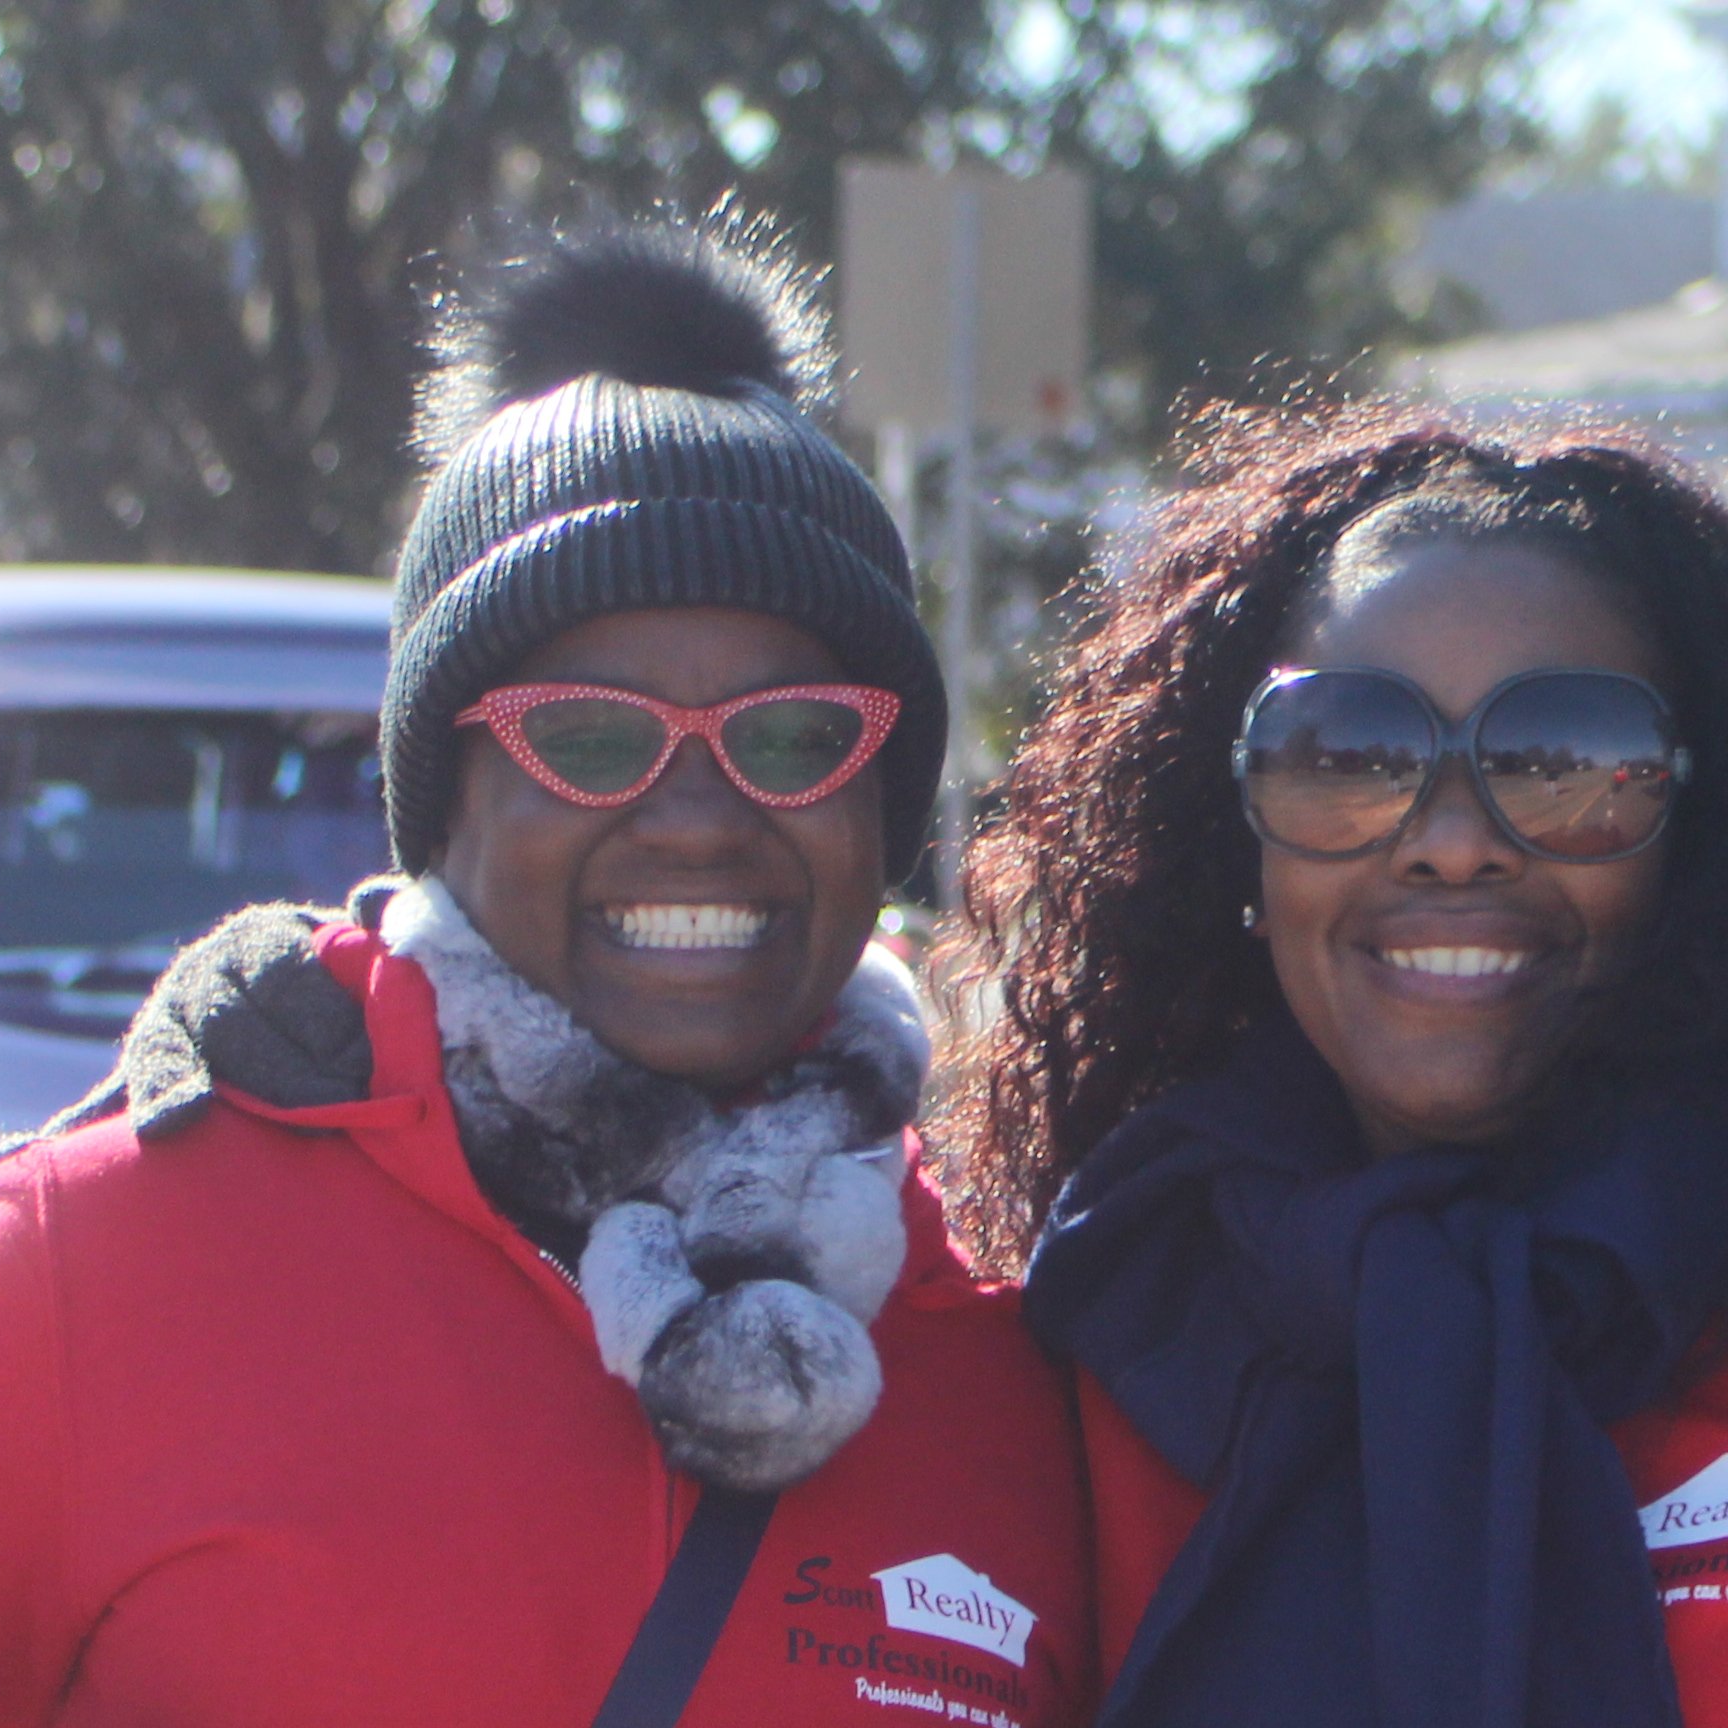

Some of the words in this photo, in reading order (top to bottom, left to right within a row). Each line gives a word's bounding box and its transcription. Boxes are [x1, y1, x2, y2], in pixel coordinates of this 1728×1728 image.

[783, 1556, 874, 1611] Scott
[902, 1575, 1017, 1647] Realty
[855, 1676, 944, 1714] Professionals
